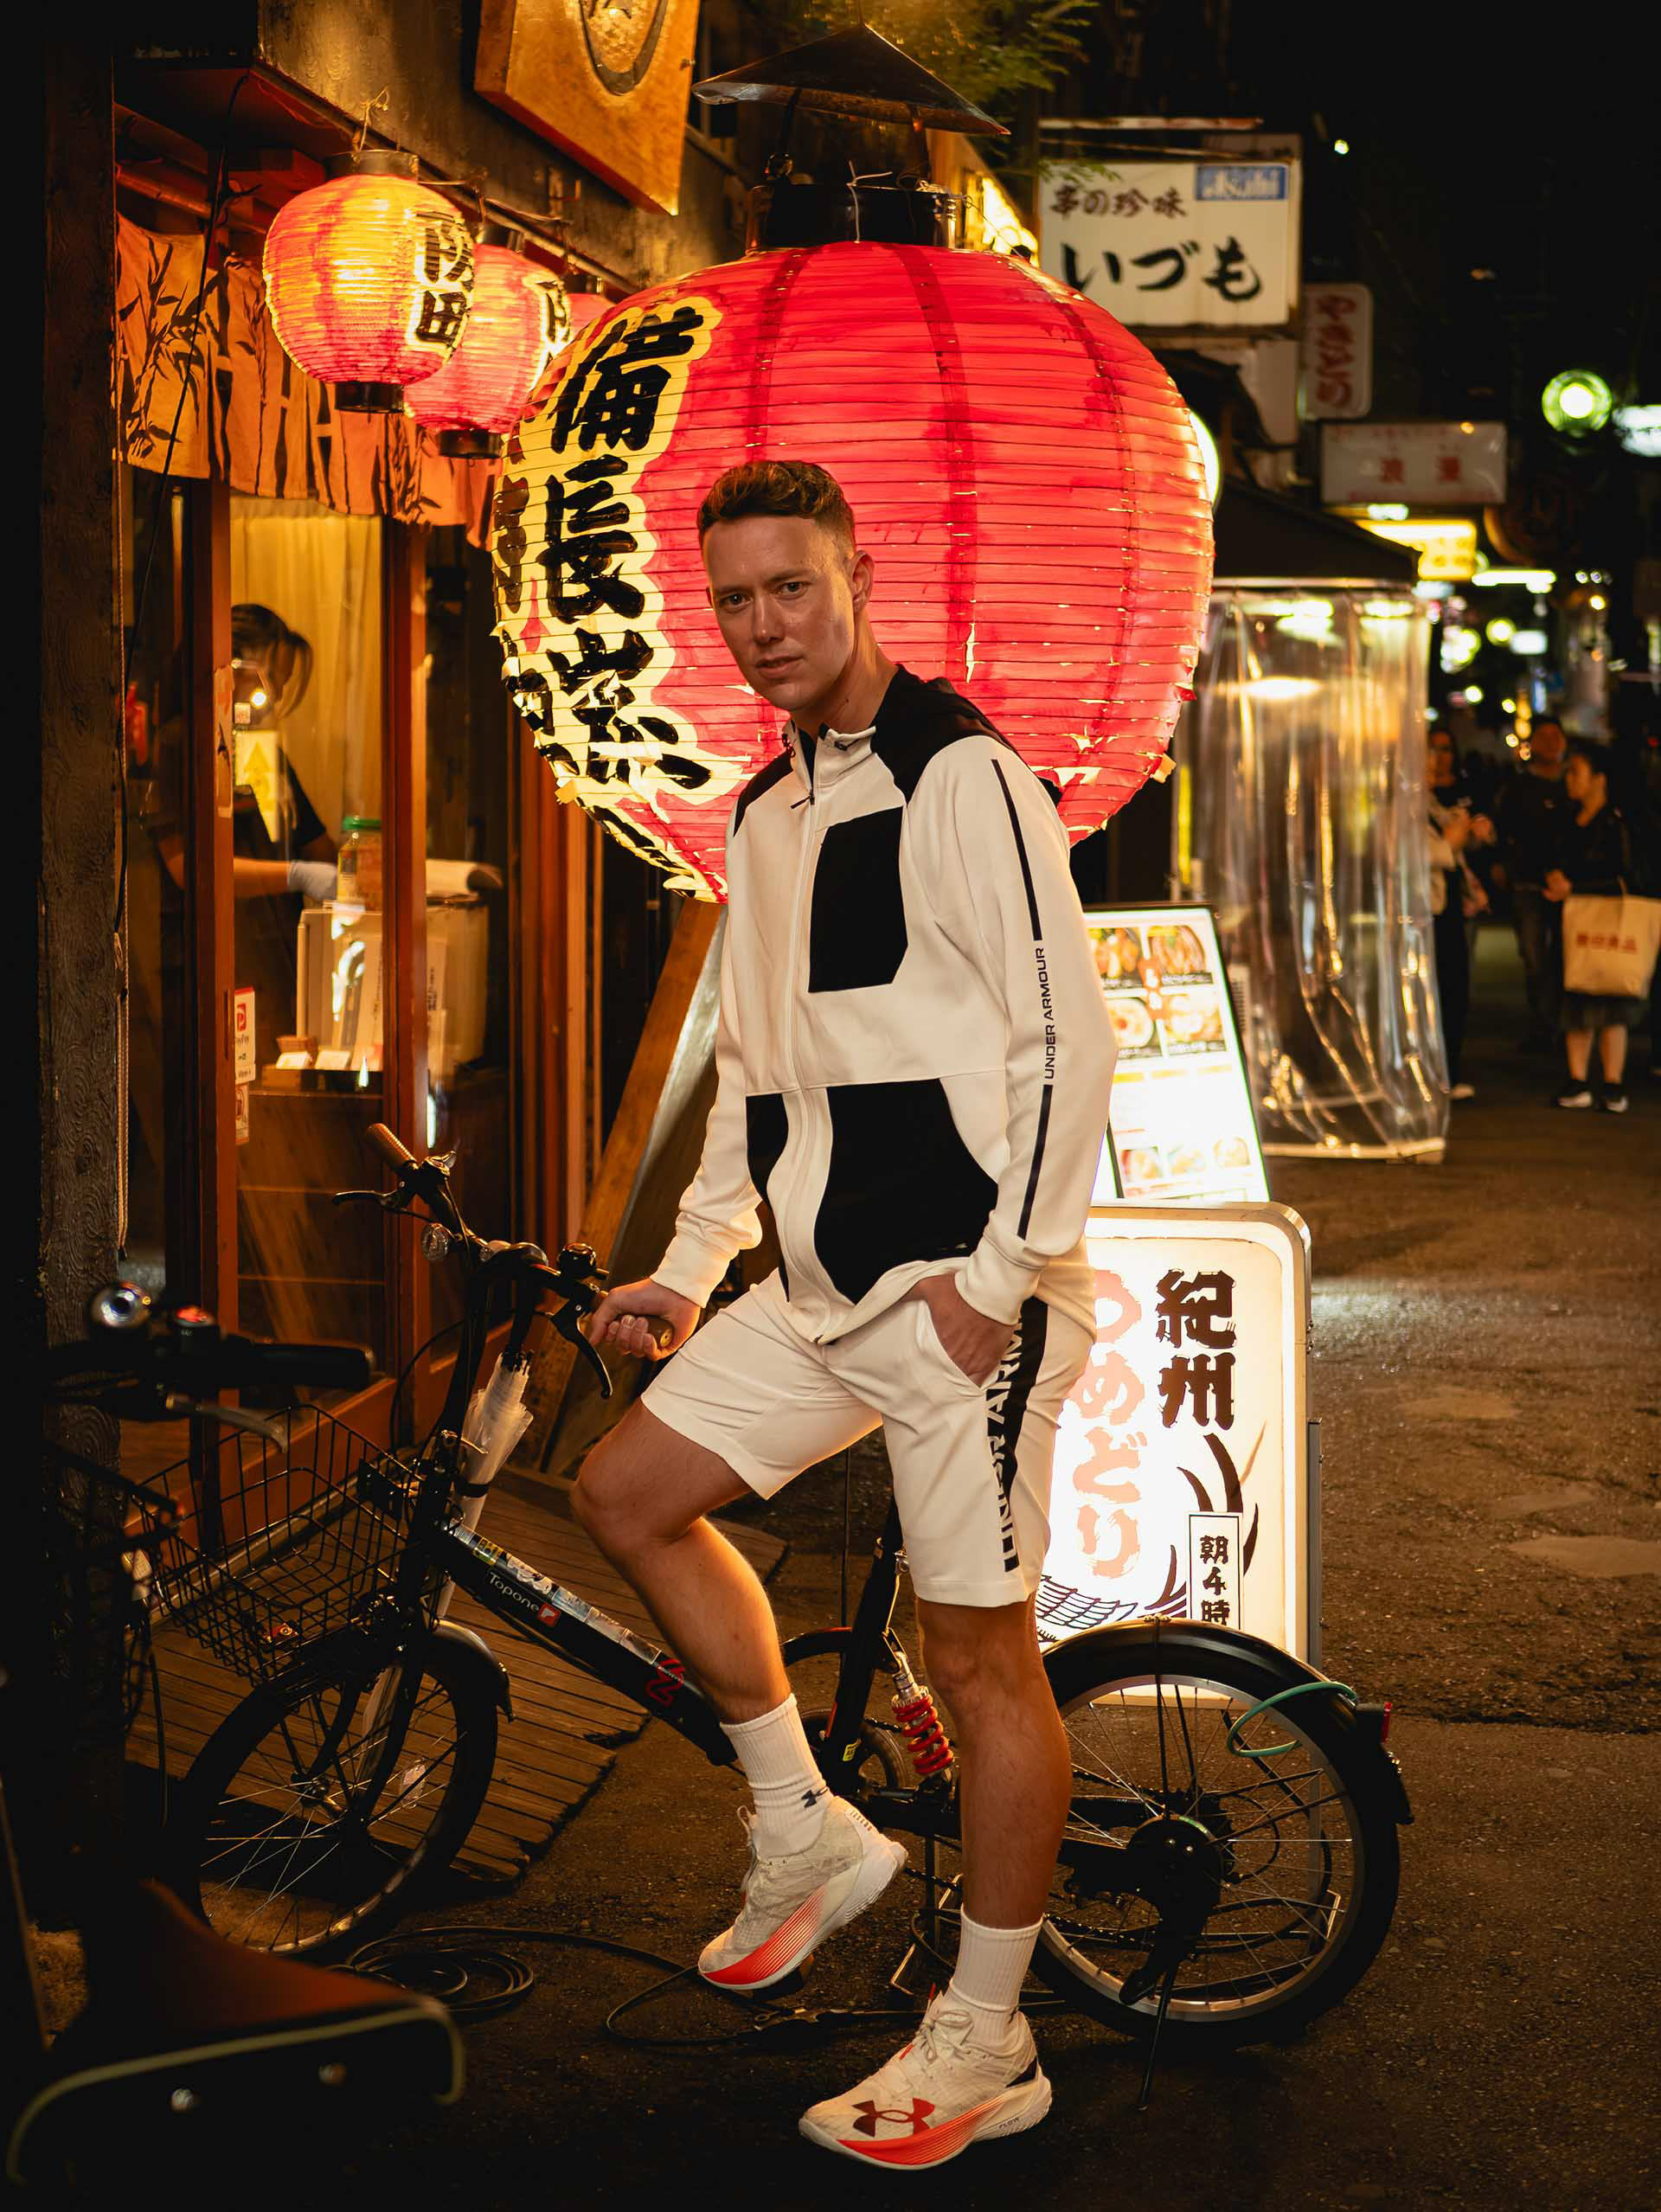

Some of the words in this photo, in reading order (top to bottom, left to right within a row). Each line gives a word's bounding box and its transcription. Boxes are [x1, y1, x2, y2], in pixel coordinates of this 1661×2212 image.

[1061, 235, 1262, 302] いづも
[1036, 947, 1055, 1021] ARMOUR
[1044, 1024, 1056, 1080] UNDER
[1156, 1267, 1236, 1430] 紀州
[1200, 1536, 1230, 1624] 朝4時
